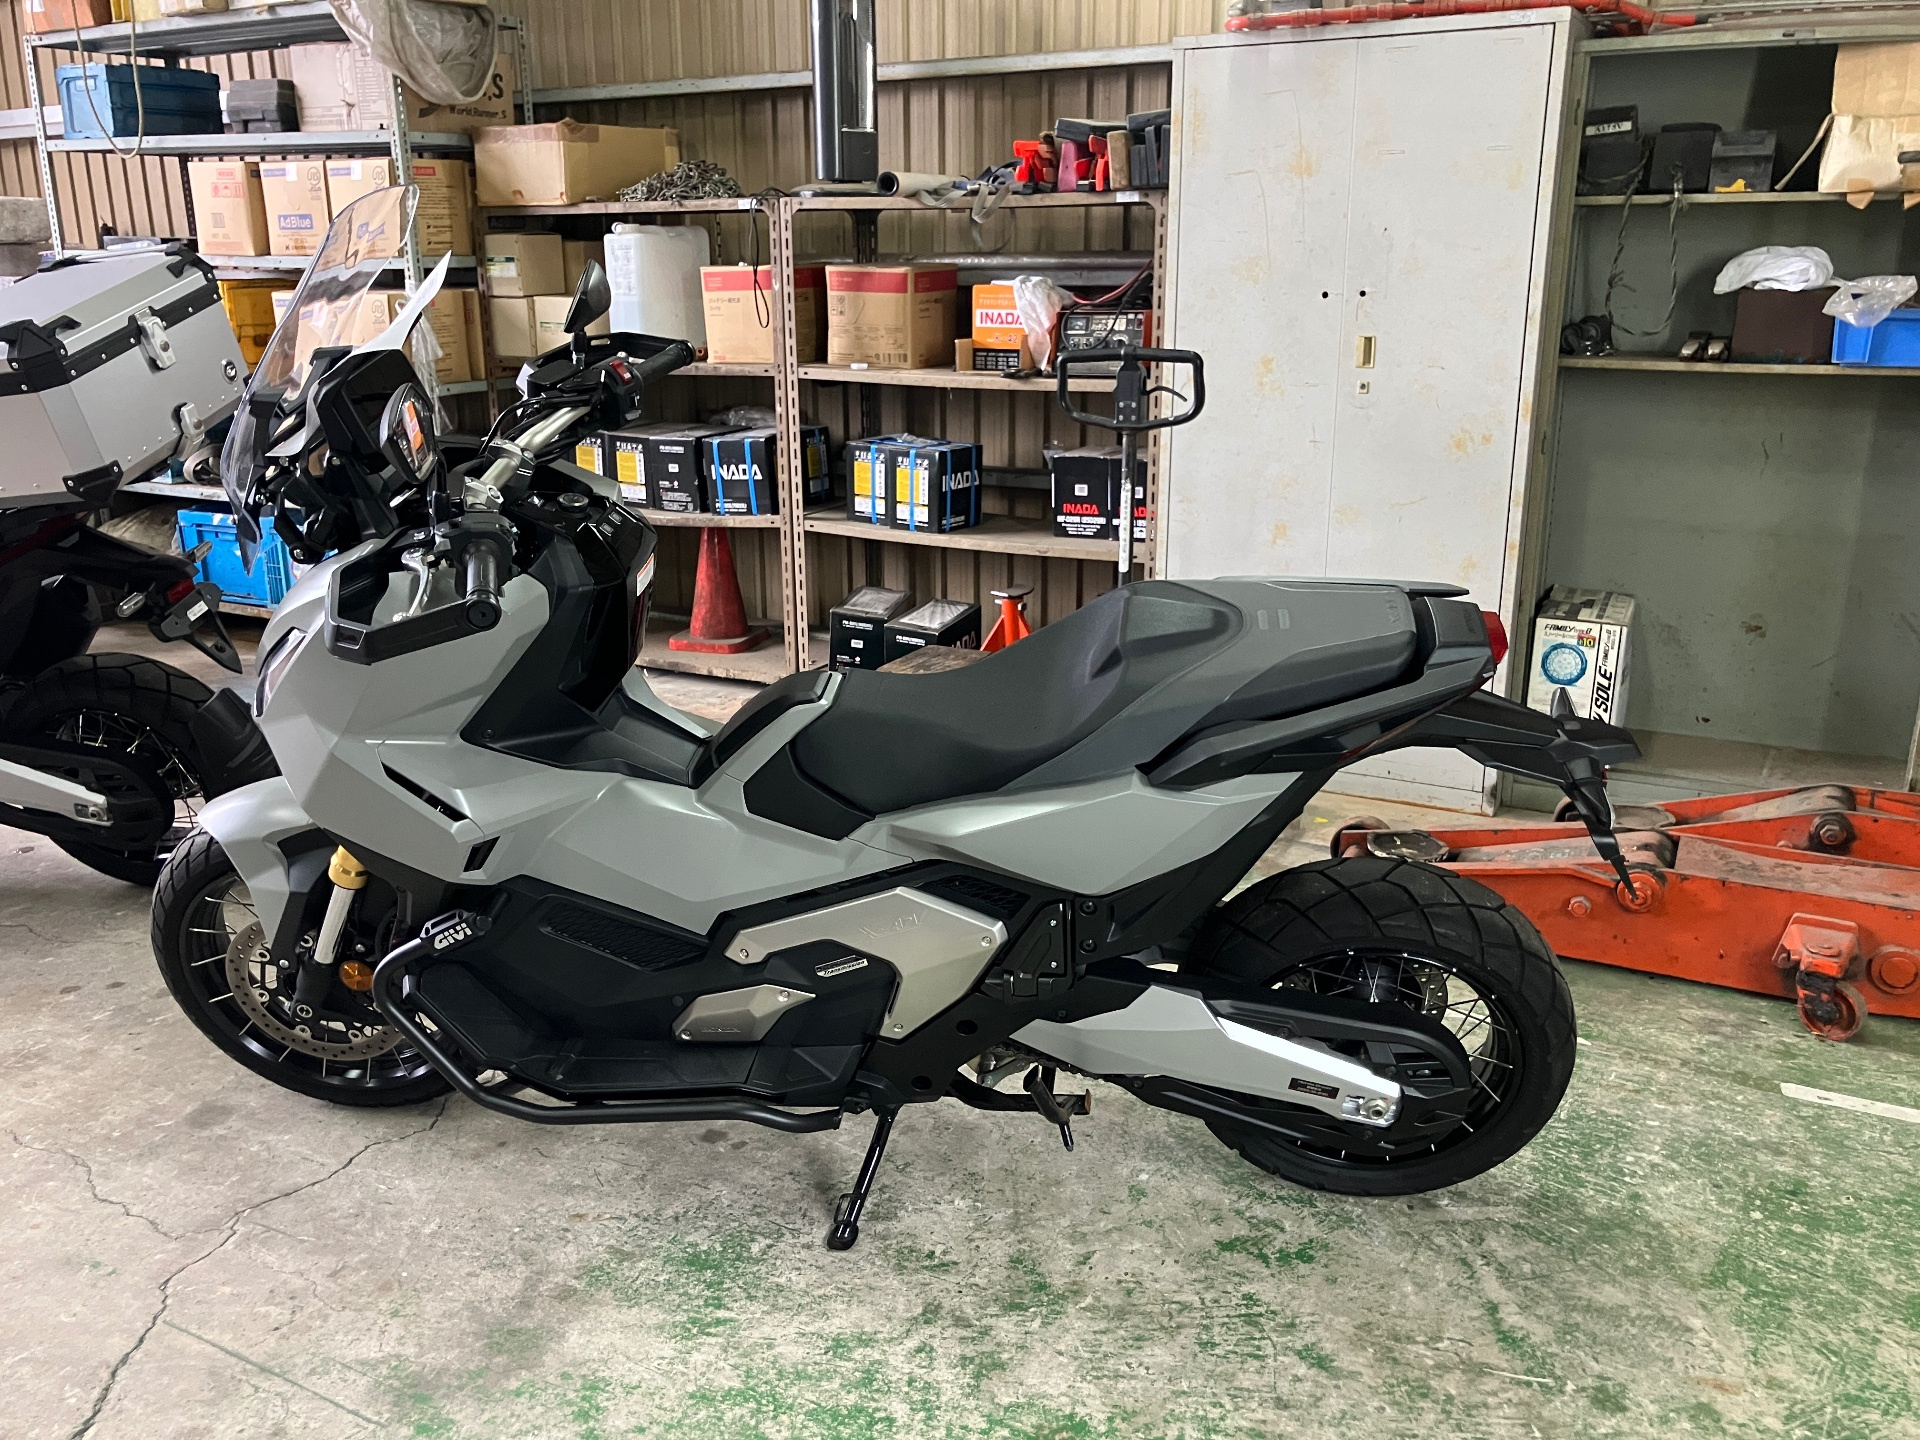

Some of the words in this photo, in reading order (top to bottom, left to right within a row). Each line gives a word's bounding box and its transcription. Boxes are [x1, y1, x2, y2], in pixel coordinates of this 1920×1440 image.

[279, 215, 312, 229] AdBlue
[711, 463, 763, 480] INADA
[942, 470, 980, 492] INADA
[1062, 503, 1099, 515] INADA
[1544, 623, 1575, 633] FAMILY
[1594, 665, 1613, 714] SOLE
[433, 922, 473, 949] GIVI
[823, 960, 865, 976] Transmission
